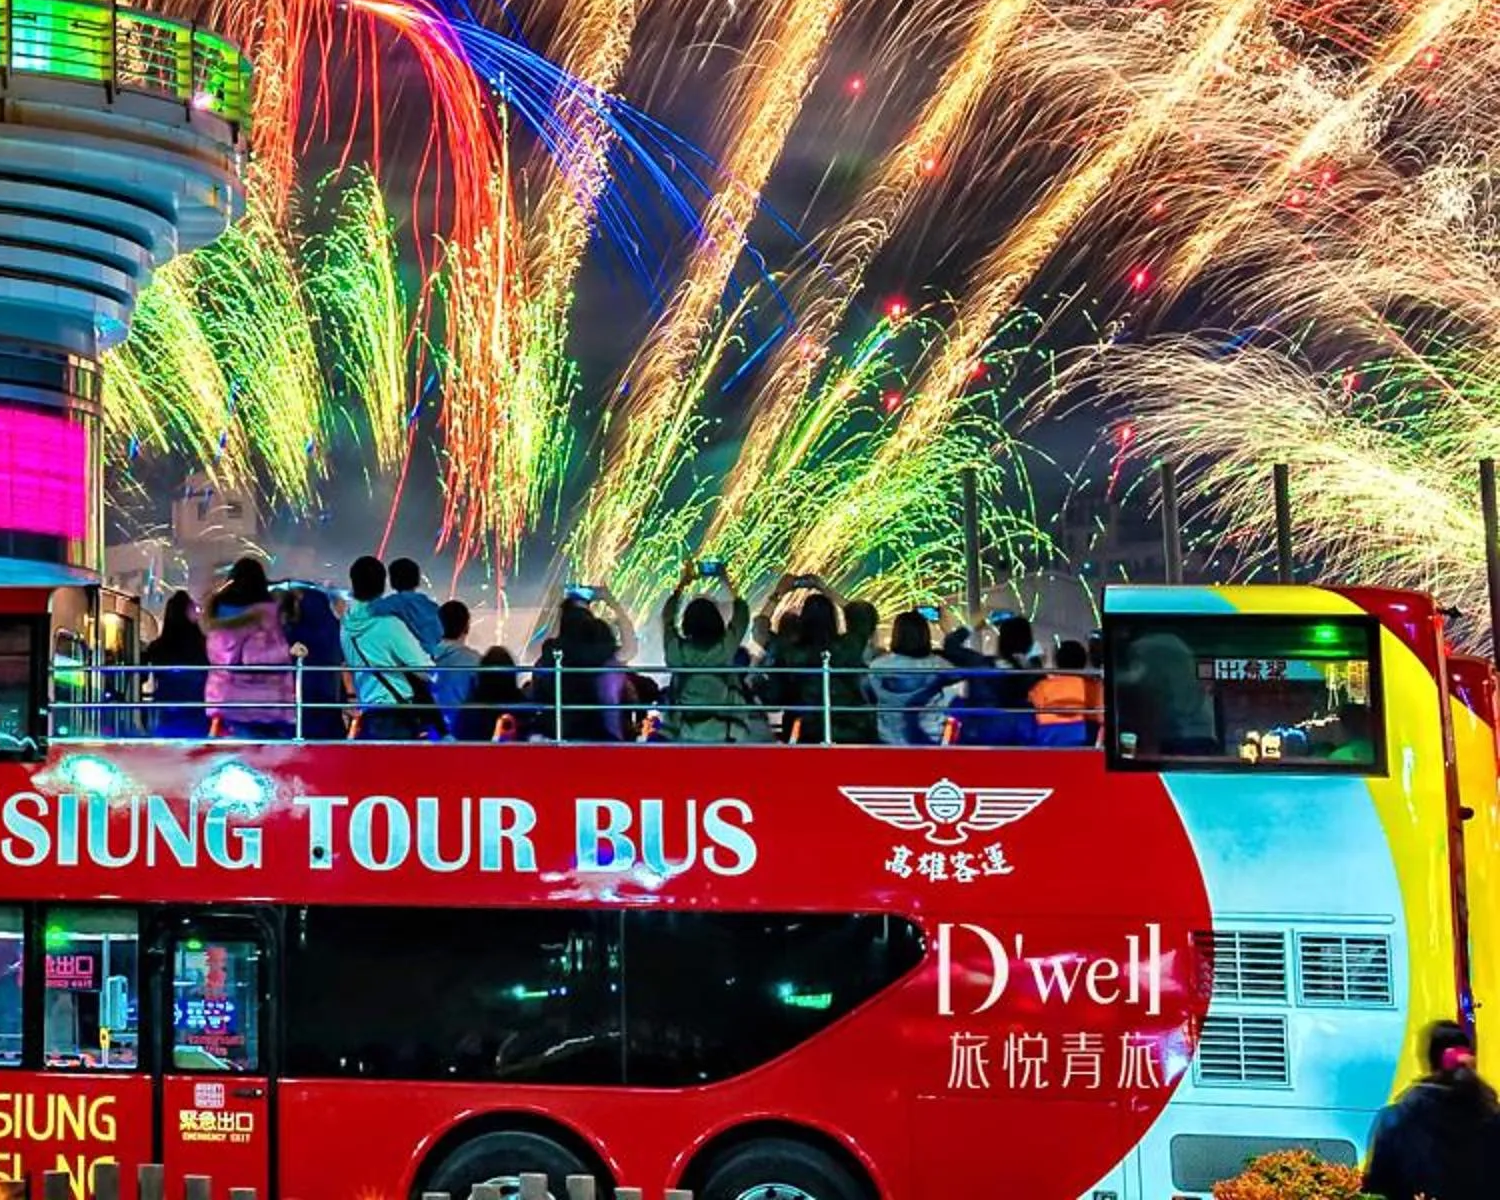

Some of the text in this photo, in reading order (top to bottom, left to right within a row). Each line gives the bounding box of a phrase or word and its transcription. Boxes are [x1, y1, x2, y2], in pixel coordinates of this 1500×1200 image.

[293, 795, 539, 873] TOUR
[574, 798, 758, 877] BUS
[937, 922, 1162, 1016] D'well
[179, 1109, 254, 1132] 緊急出口
